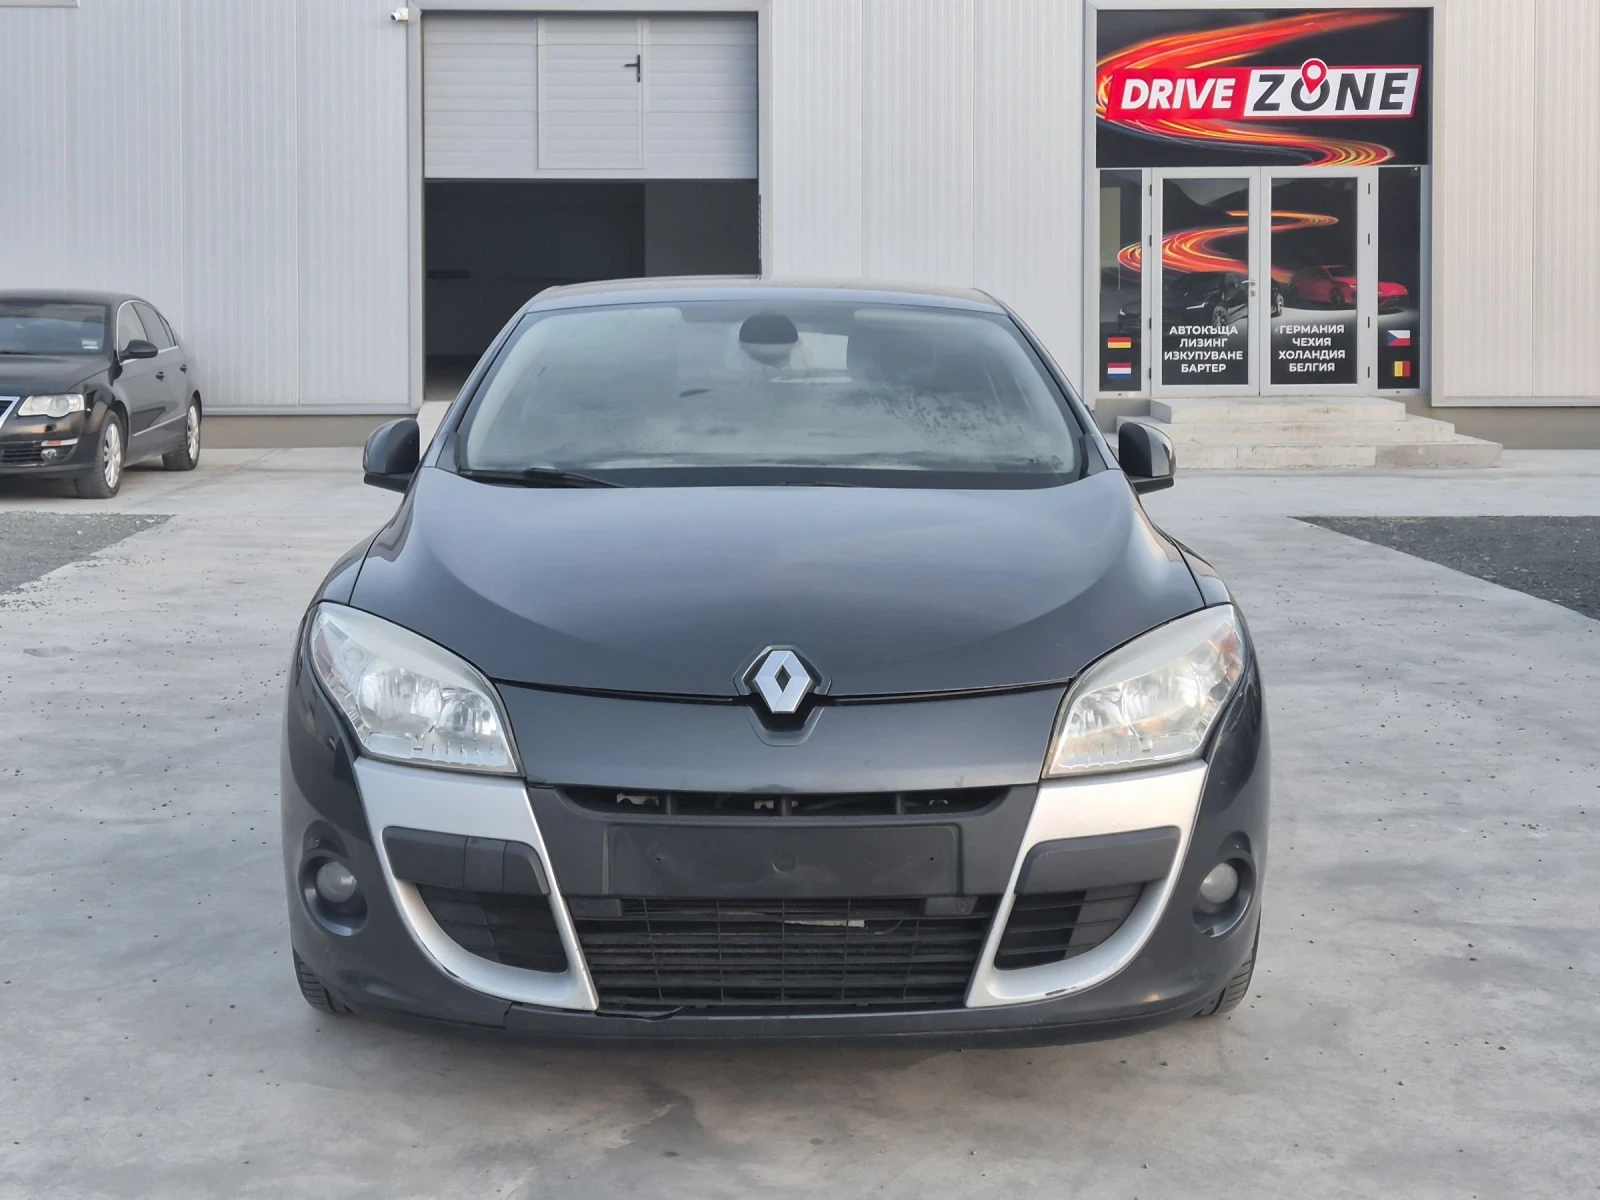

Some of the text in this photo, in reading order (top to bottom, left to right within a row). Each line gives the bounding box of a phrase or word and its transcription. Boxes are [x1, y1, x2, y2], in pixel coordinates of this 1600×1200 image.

[1120, 72, 1410, 112] DRIVE ZONE
[1169, 325, 1238, 336] АВТОКЪЩА
[1279, 324, 1345, 334] ГЕРМАНИЯ
[1179, 338, 1228, 348] ЛИЗИНГ
[1292, 337, 1332, 347] ЧЕХИЯ
[1164, 350, 1244, 360] ИЗКУПУВАНЕ
[1278, 349, 1346, 361] ХОЛАНДИЯ
[1181, 363, 1227, 373] БАРТЕР
[1289, 362, 1335, 372] БЕЛГИЯ
